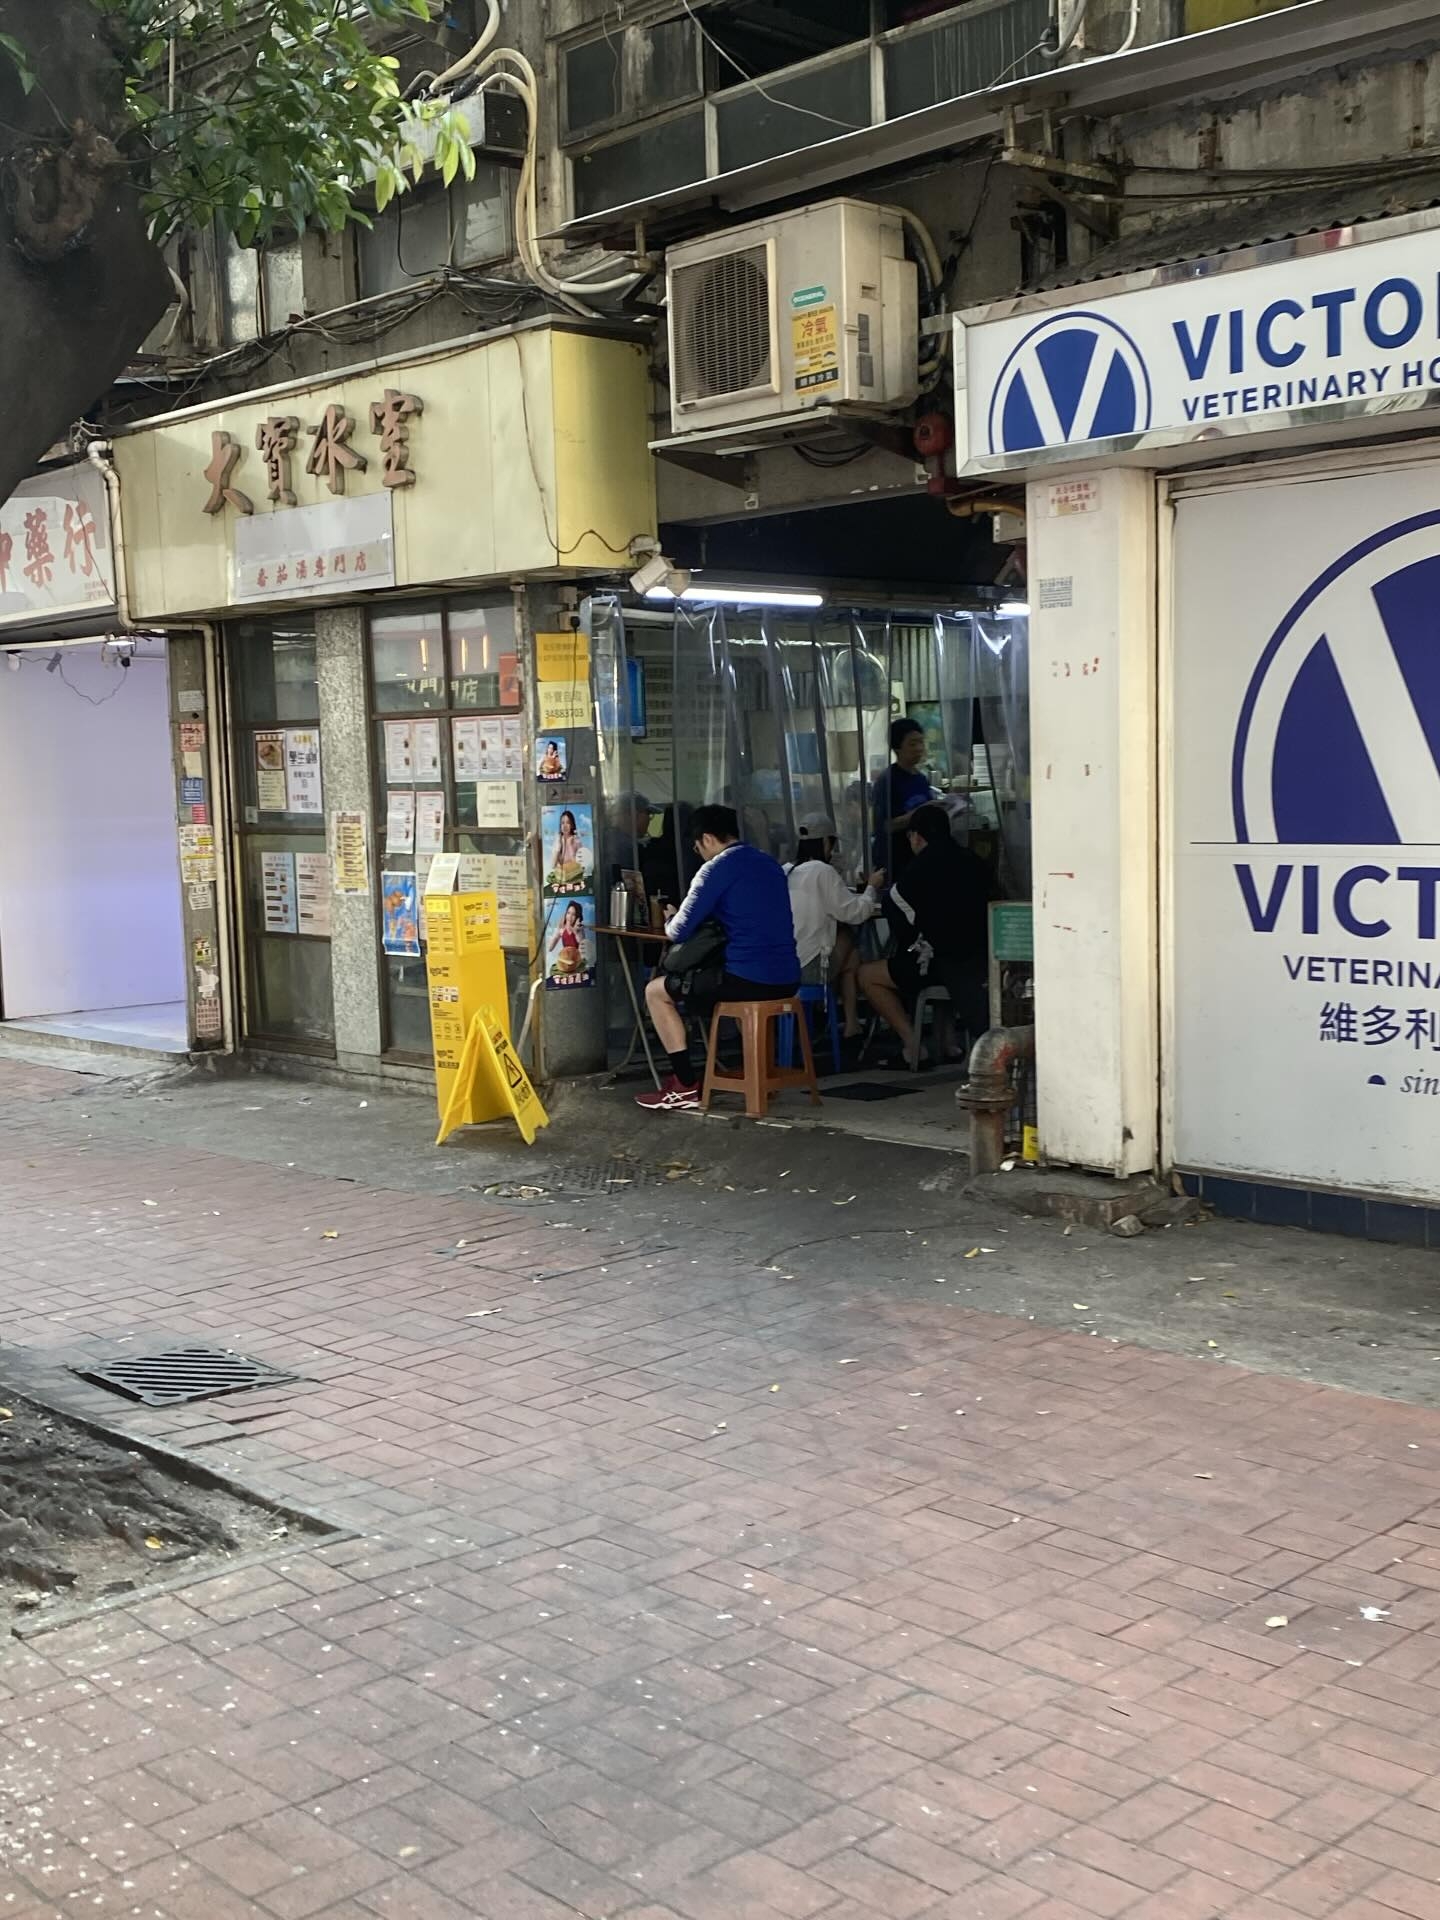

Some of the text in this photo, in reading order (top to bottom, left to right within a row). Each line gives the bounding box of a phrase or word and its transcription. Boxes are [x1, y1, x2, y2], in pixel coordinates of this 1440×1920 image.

[1172, 271, 1440, 381] VICTO
[1183, 365, 1391, 421] VETERINARY
[256, 551, 369, 588] 番茄湯專門店
[1319, 1001, 1440, 1052] 維多利
